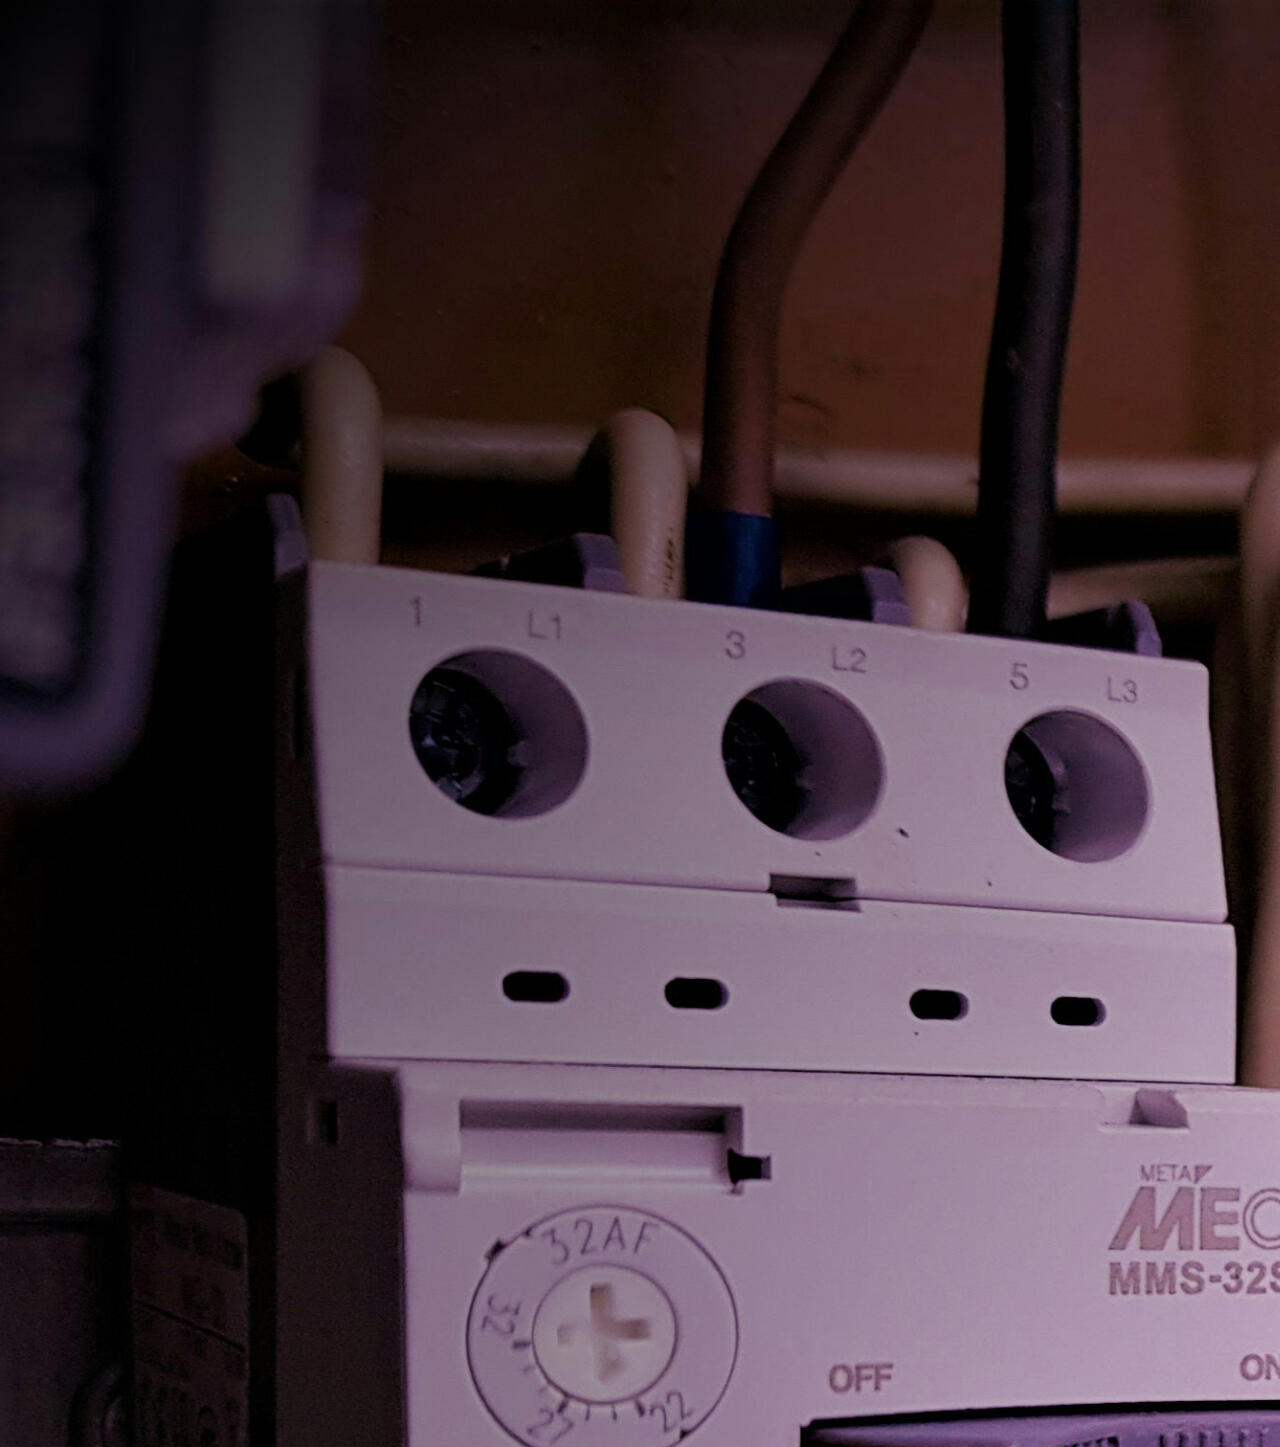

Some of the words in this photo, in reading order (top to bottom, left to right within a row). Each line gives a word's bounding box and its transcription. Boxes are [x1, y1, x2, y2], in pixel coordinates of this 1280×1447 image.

[409, 596, 422, 627] 1
[528, 610, 561, 640] L1
[724, 630, 746, 660] 3
[831, 646, 867, 674] L2
[1009, 663, 1030, 691] 5
[1106, 676, 1139, 703] L3
[828, 1362, 894, 1394] OFF
